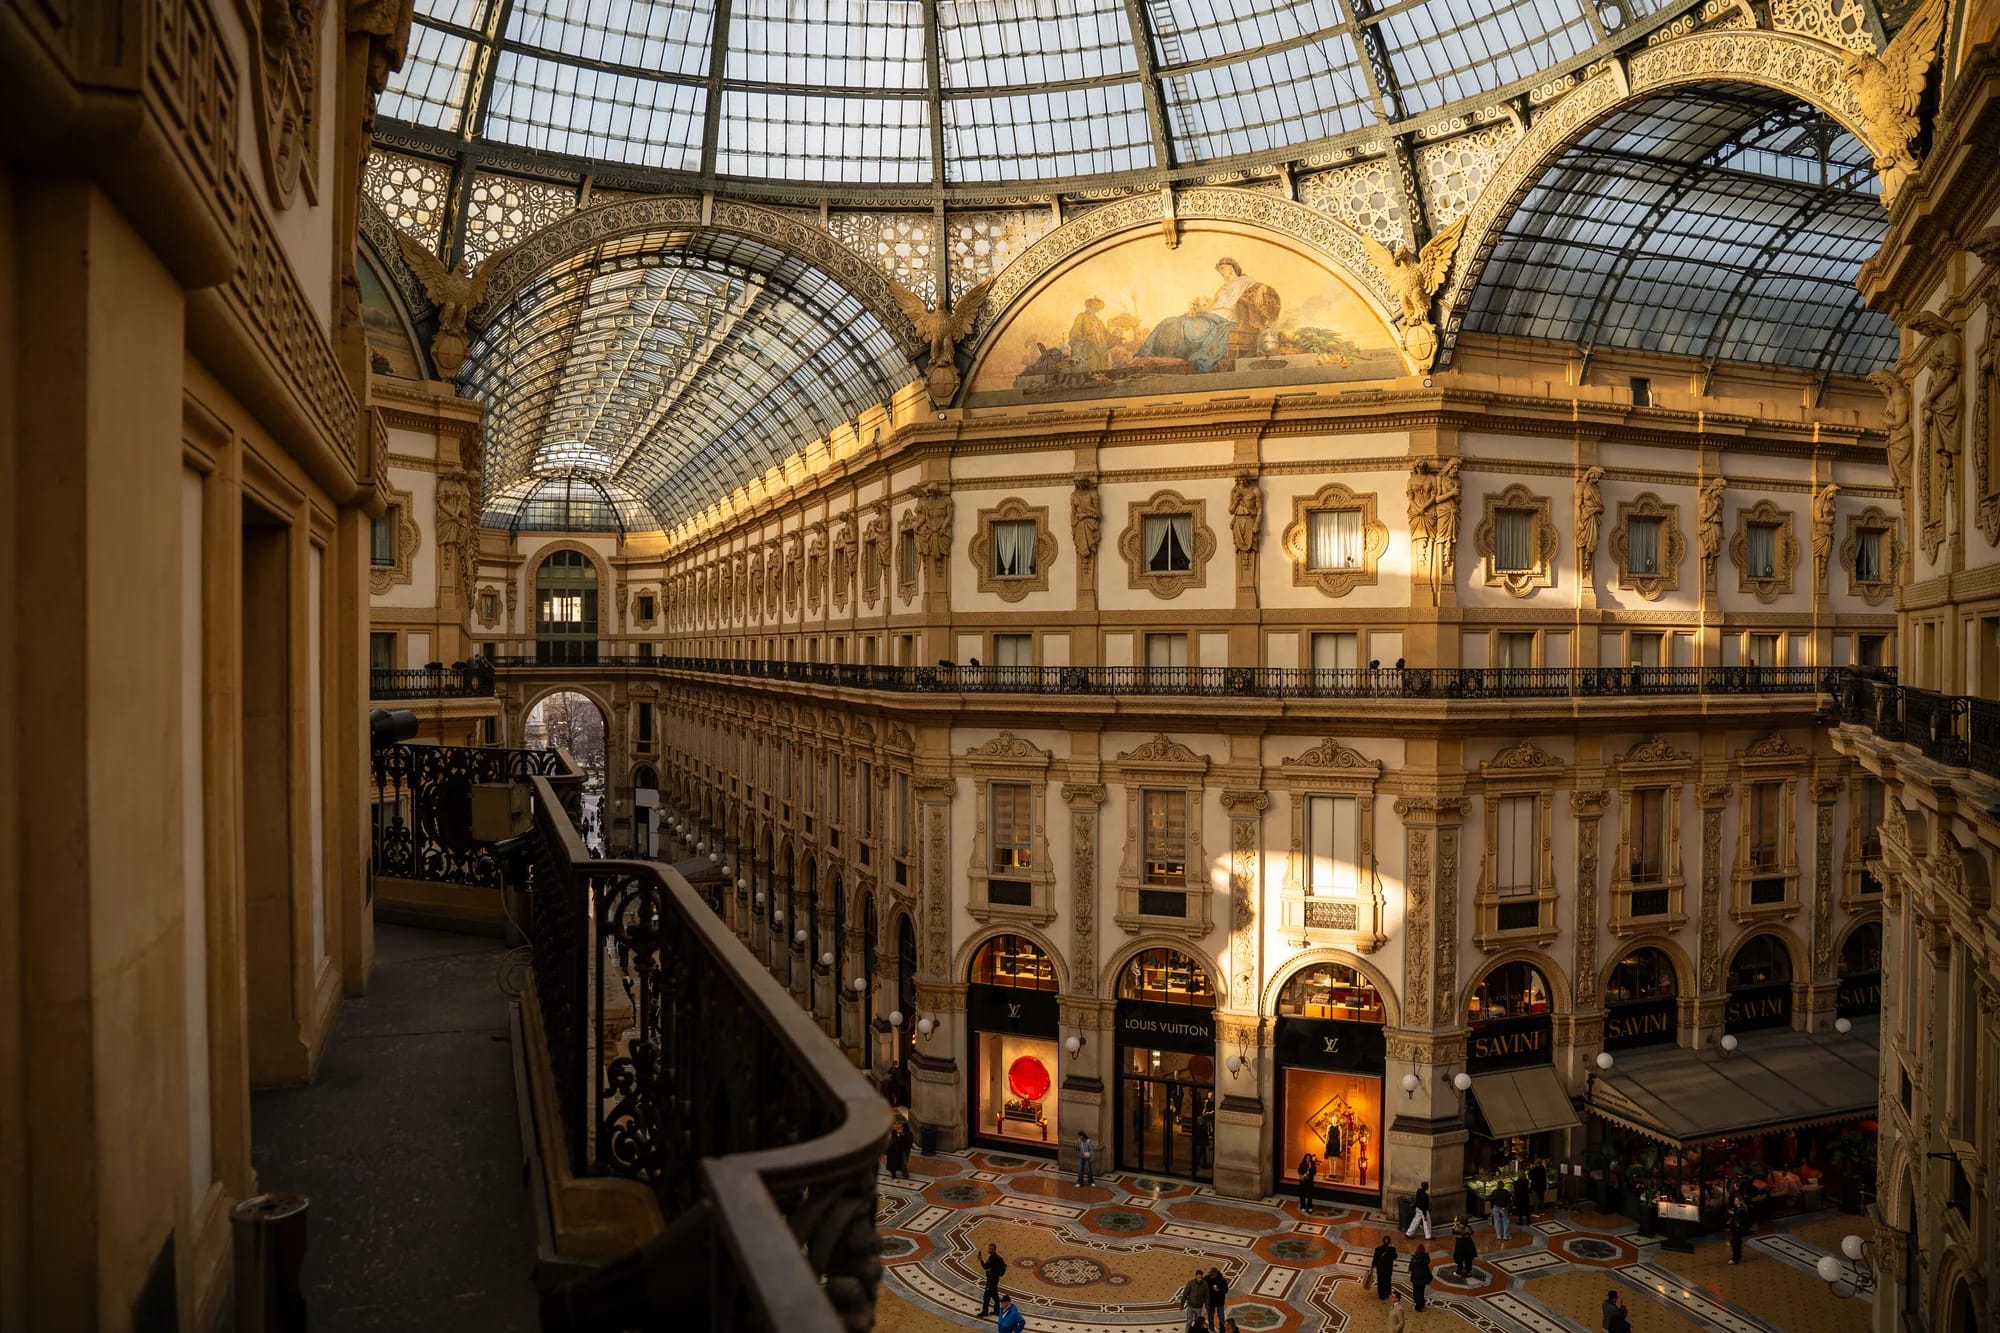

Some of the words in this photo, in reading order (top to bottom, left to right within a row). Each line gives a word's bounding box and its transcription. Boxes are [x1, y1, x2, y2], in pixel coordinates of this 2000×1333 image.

[1840, 984, 1880, 1008] SAVIN
[1729, 996, 1782, 1022] SAVINI
[1125, 1018, 1157, 1031] LOUIS
[1159, 1022, 1209, 1037] VUITTON
[1608, 1012, 1667, 1038] SAVINI
[1322, 1036, 1339, 1053] LV
[1475, 1031, 1540, 1058] SAVINI
